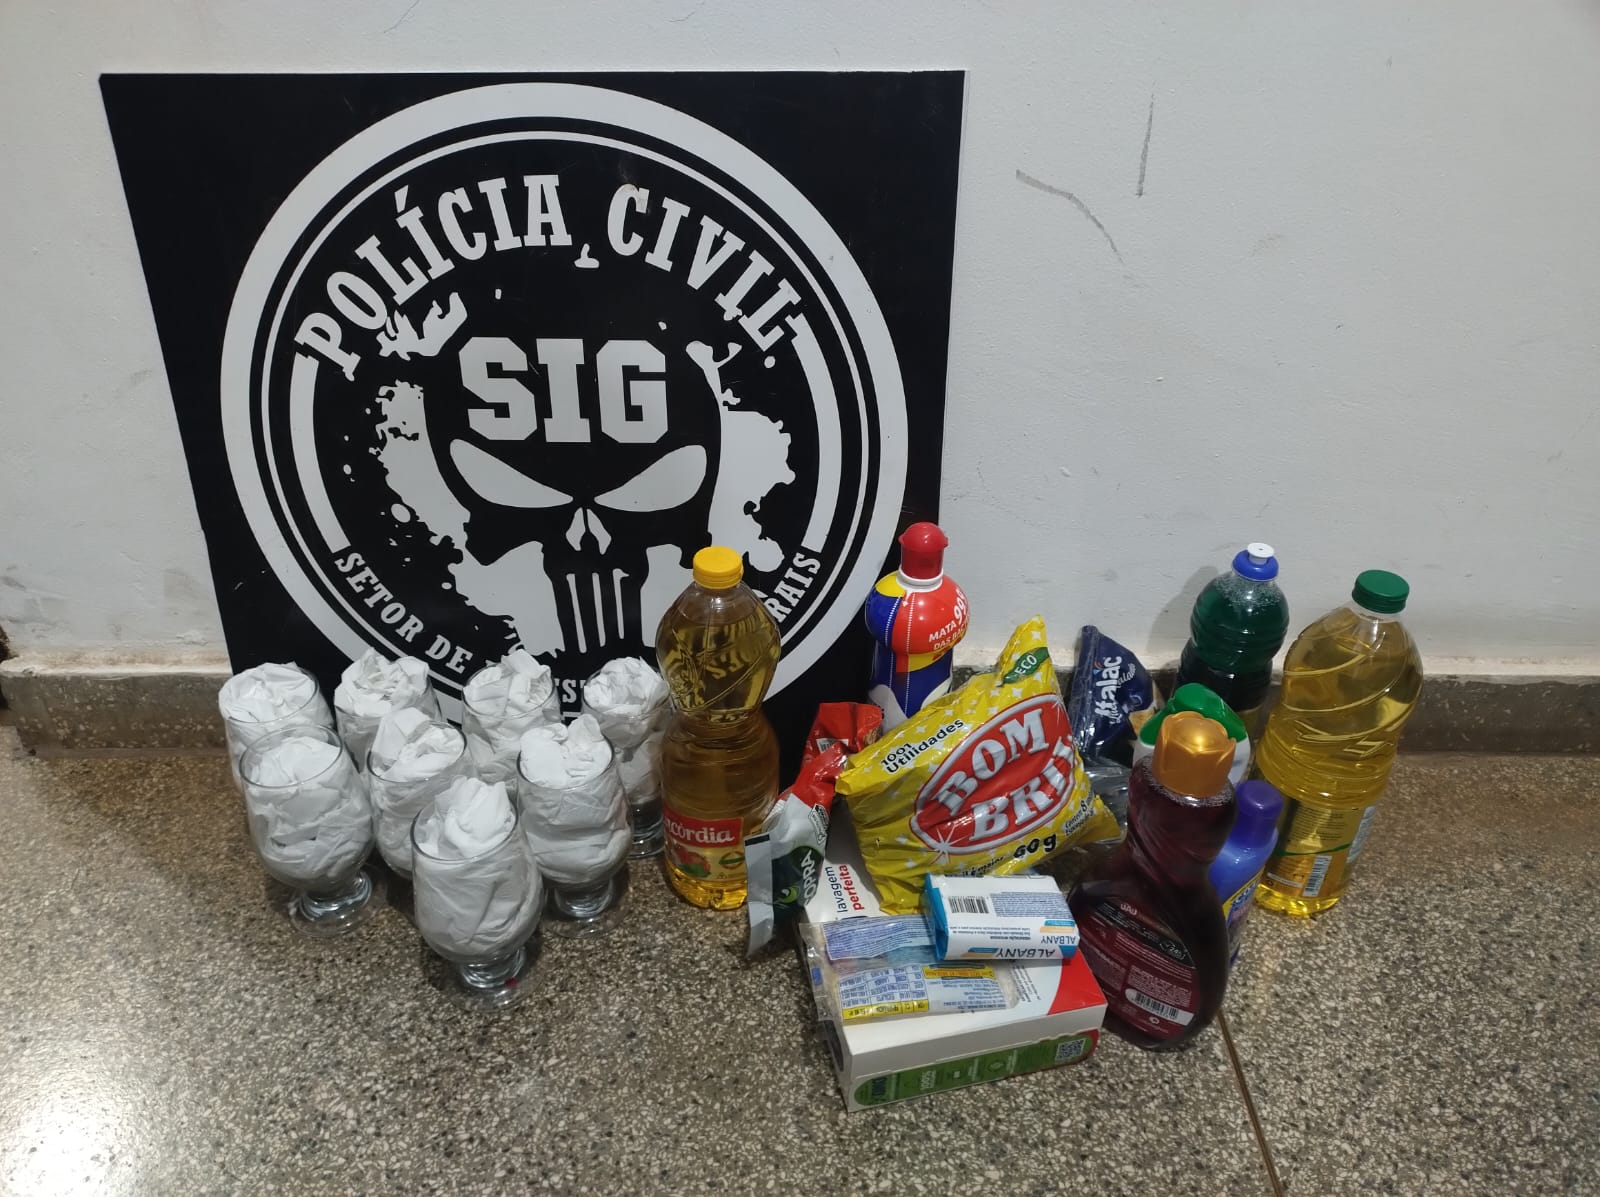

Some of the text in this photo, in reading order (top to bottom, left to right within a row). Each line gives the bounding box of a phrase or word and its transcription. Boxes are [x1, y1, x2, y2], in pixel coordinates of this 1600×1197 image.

[294, 174, 801, 381] POLÍCIA CIVIL
[458, 336, 668, 443] SIG
[334, 552, 822, 674] SETOR DE RAIS
[928, 620, 956, 643] MATA
[933, 637, 951, 650] DAS
[1015, 654, 1038, 676] ECO
[1094, 655, 1123, 719] Italac
[880, 742, 913, 767] 1001
[885, 718, 965, 774] Utilidades
[938, 708, 1050, 817] BOM
[825, 866, 848, 913] lavagem
[838, 864, 865, 911] perfeita
[996, 947, 1057, 958] ALBANY
[1040, 935, 1077, 945] ALBANY
